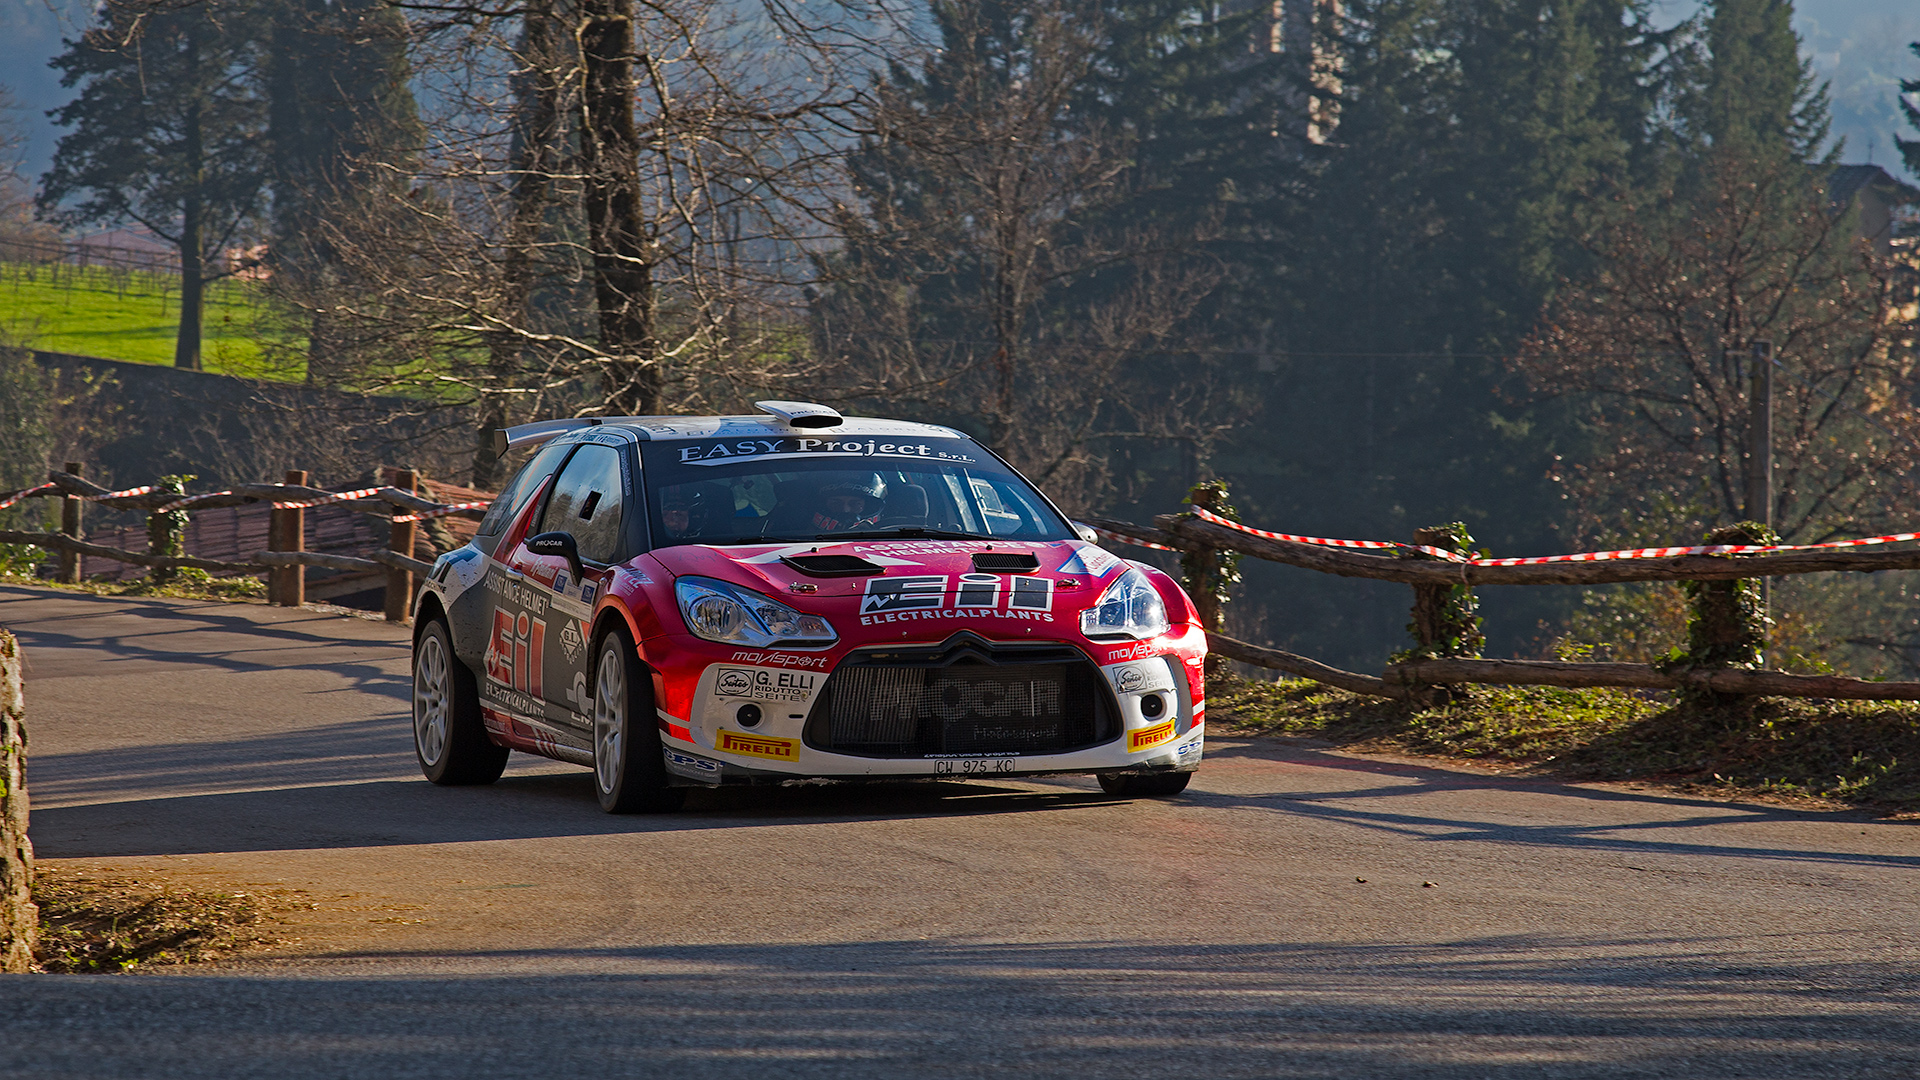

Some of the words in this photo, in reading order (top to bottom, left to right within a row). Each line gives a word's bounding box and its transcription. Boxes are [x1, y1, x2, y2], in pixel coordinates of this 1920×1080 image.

[678, 439, 785, 462] EASY
[795, 439, 931, 457] Project
[483, 568, 520, 604] ASSISTANCE
[860, 608, 1055, 626] ELECTRICALPLANTS
[731, 651, 828, 668] movisport
[756, 671, 772, 686] G.
[778, 672, 814, 690] ELLI
[754, 685, 812, 696] RIDUTTOI
[754, 692, 806, 702] SEITE
[1133, 723, 1173, 747] PIRELLI
[723, 734, 792, 757] PIRELLI
[937, 761, 953, 774] CW
[963, 760, 987, 773] 975
[996, 760, 1013, 772] KC
